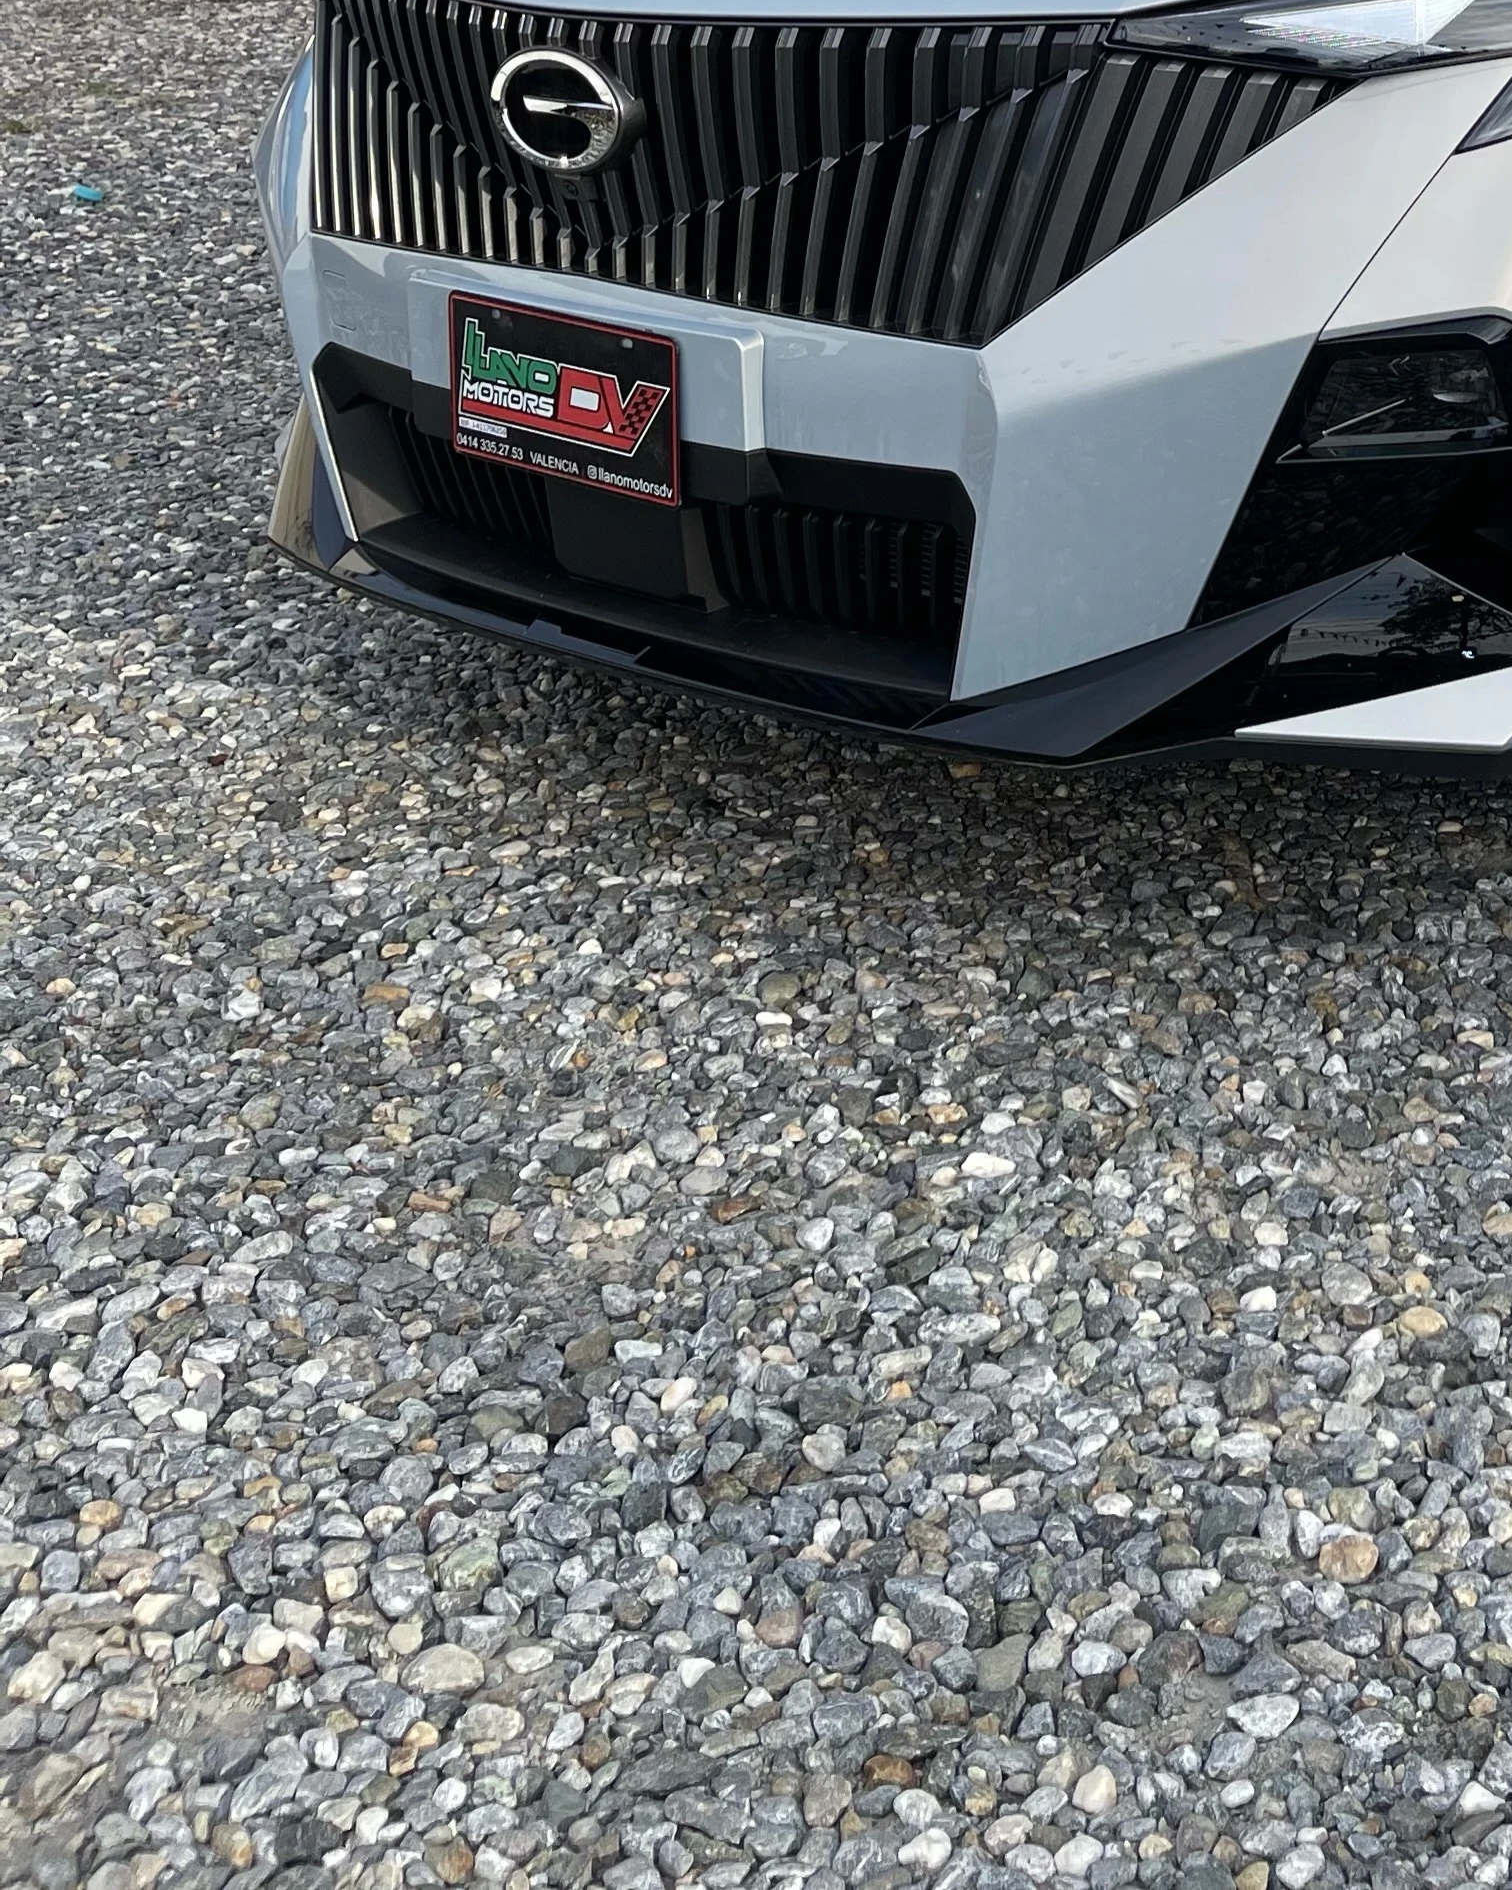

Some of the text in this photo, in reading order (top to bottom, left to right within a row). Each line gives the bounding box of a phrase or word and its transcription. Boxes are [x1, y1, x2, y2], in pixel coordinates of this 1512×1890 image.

[464, 318, 558, 396] LLANO
[462, 380, 555, 418] MOTORS
[456, 432, 478, 448] 0414
[530, 451, 579, 475] VALENCIA
